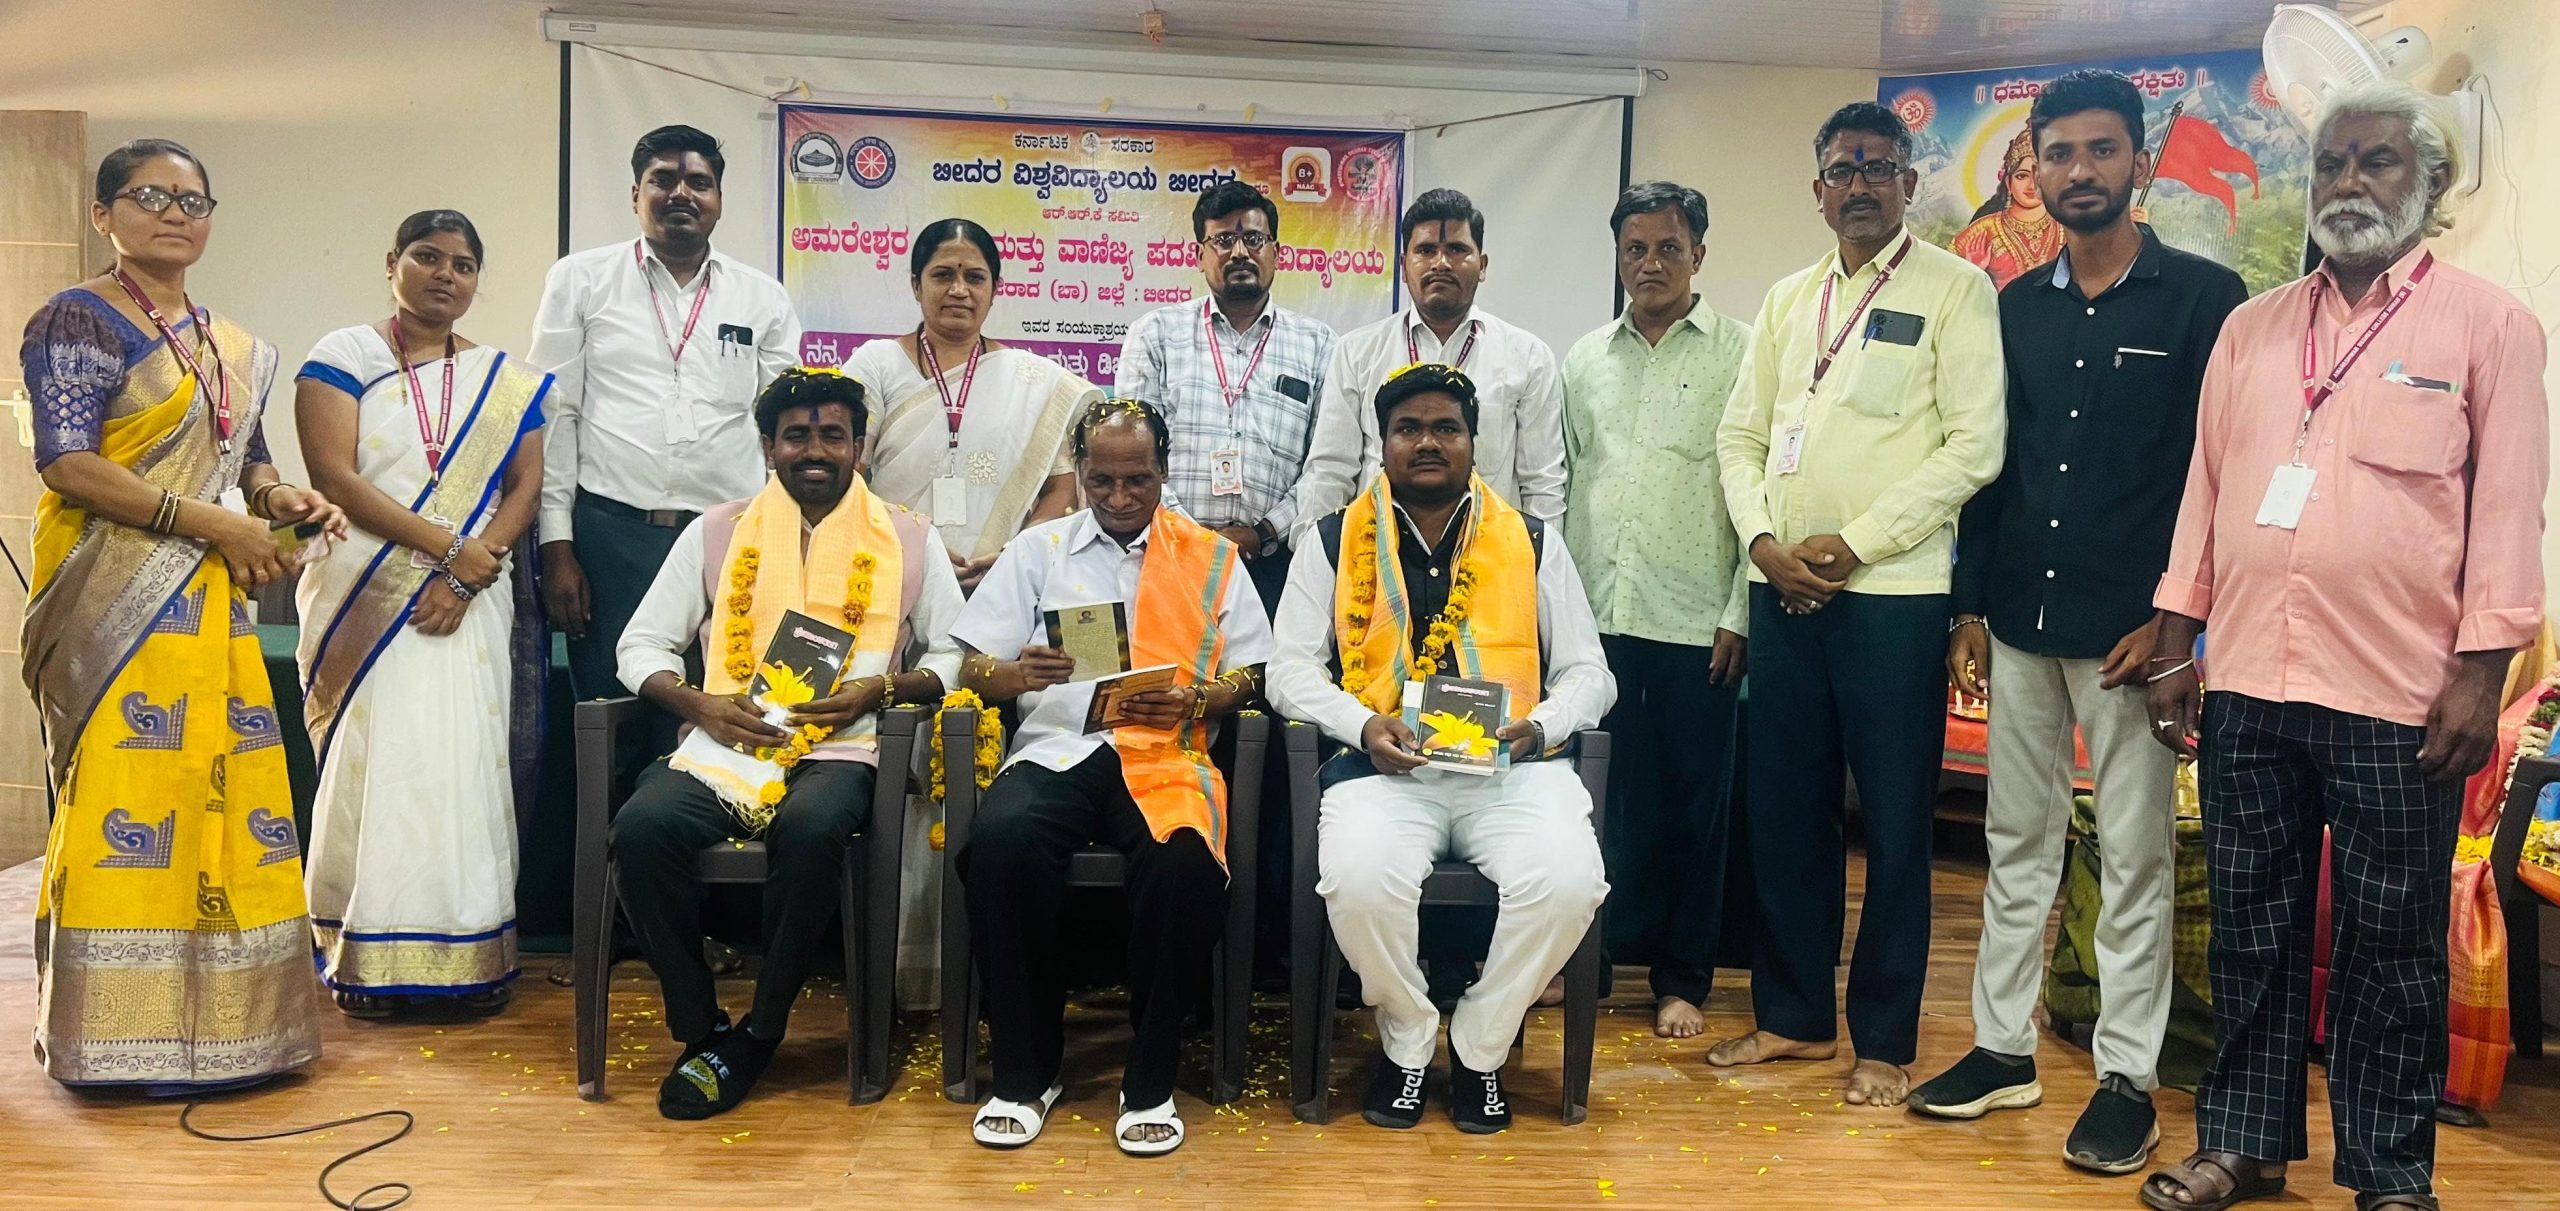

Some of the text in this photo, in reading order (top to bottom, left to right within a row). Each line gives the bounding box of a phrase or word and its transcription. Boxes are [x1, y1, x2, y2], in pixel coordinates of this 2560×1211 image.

[1014, 133, 1154, 153] ಕರ್ನಾಟಕ ಸರಕಾರ
[932, 157, 1002, 184] ಬೀದರ
[1013, 160, 1157, 204] ವಿಶ್ವವಿದ್ಯಾಲಯ
[1298, 168, 1312, 178] B+
[791, 221, 909, 270] ಅಮರೇಶ್ವರ
[1058, 233, 1133, 280] ವಾಣಿಜ್ಯ
[1051, 279, 1088, 303] (ಬಾ)
[1143, 286, 1192, 303] ಬೀದರ
[1022, 319, 1050, 334] ಇವರ
